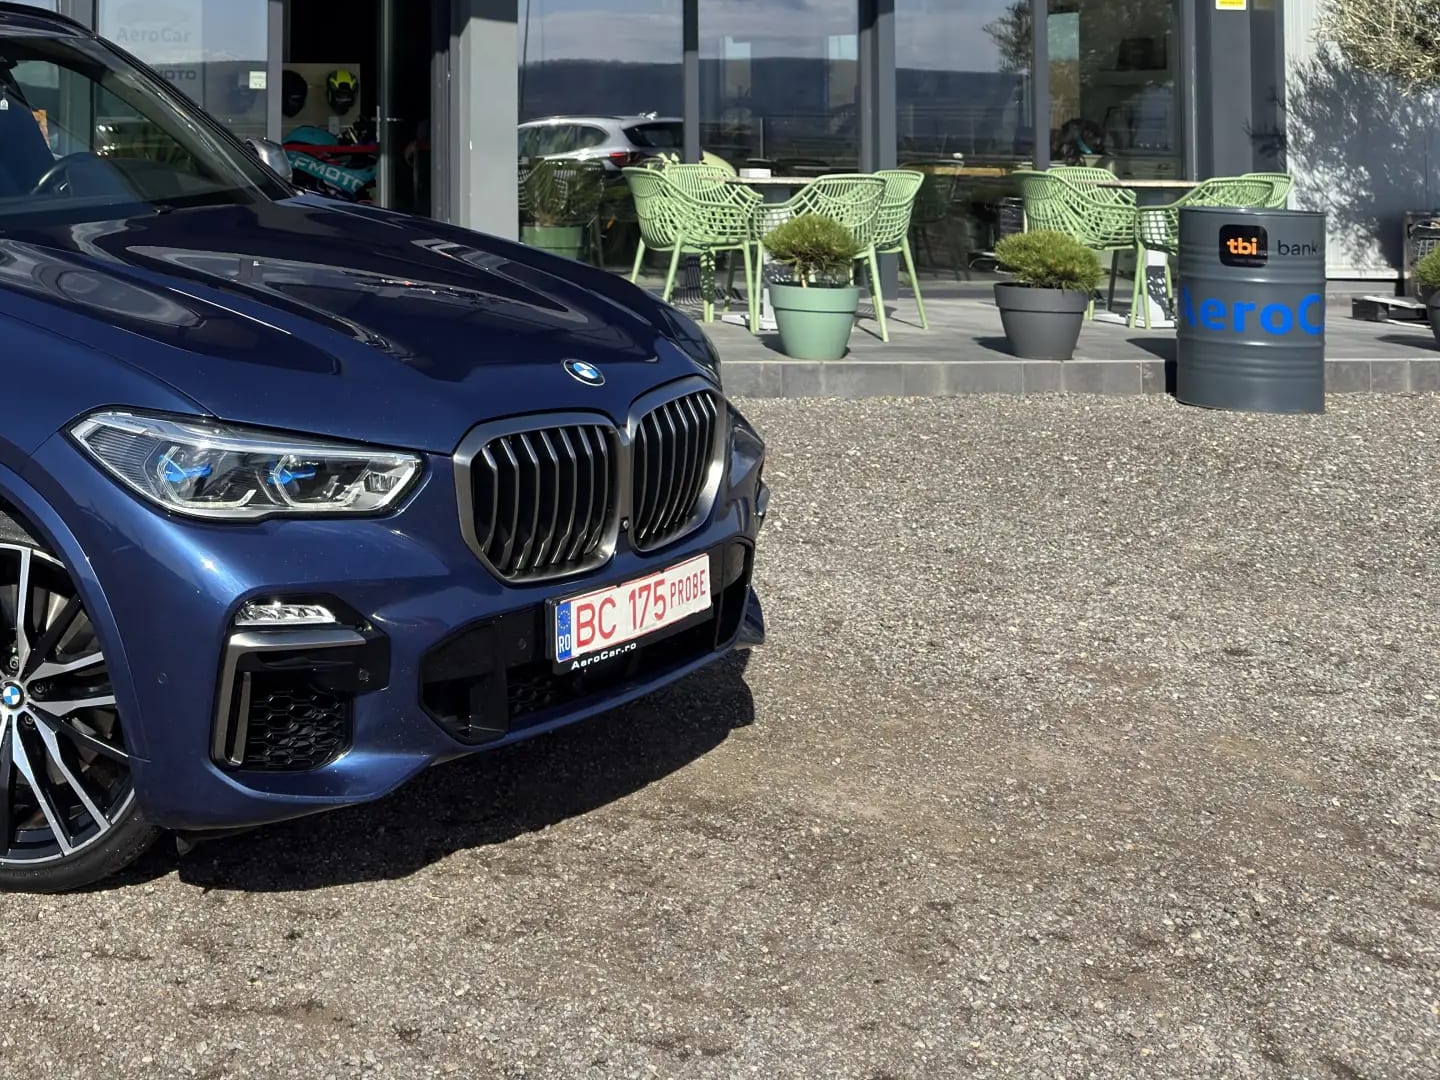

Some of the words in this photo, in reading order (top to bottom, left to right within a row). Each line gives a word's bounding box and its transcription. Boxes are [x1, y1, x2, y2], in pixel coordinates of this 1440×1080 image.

[116, 27, 192, 43] AeroCar
[1227, 237, 1258, 255] tbi
[1277, 240, 1318, 256] bank
[576, 596, 617, 649] BC
[628, 578, 667, 631] 175
[670, 569, 706, 609] PROBE
[558, 633, 571, 654] RO
[571, 642, 637, 670] AeroCar.ro
